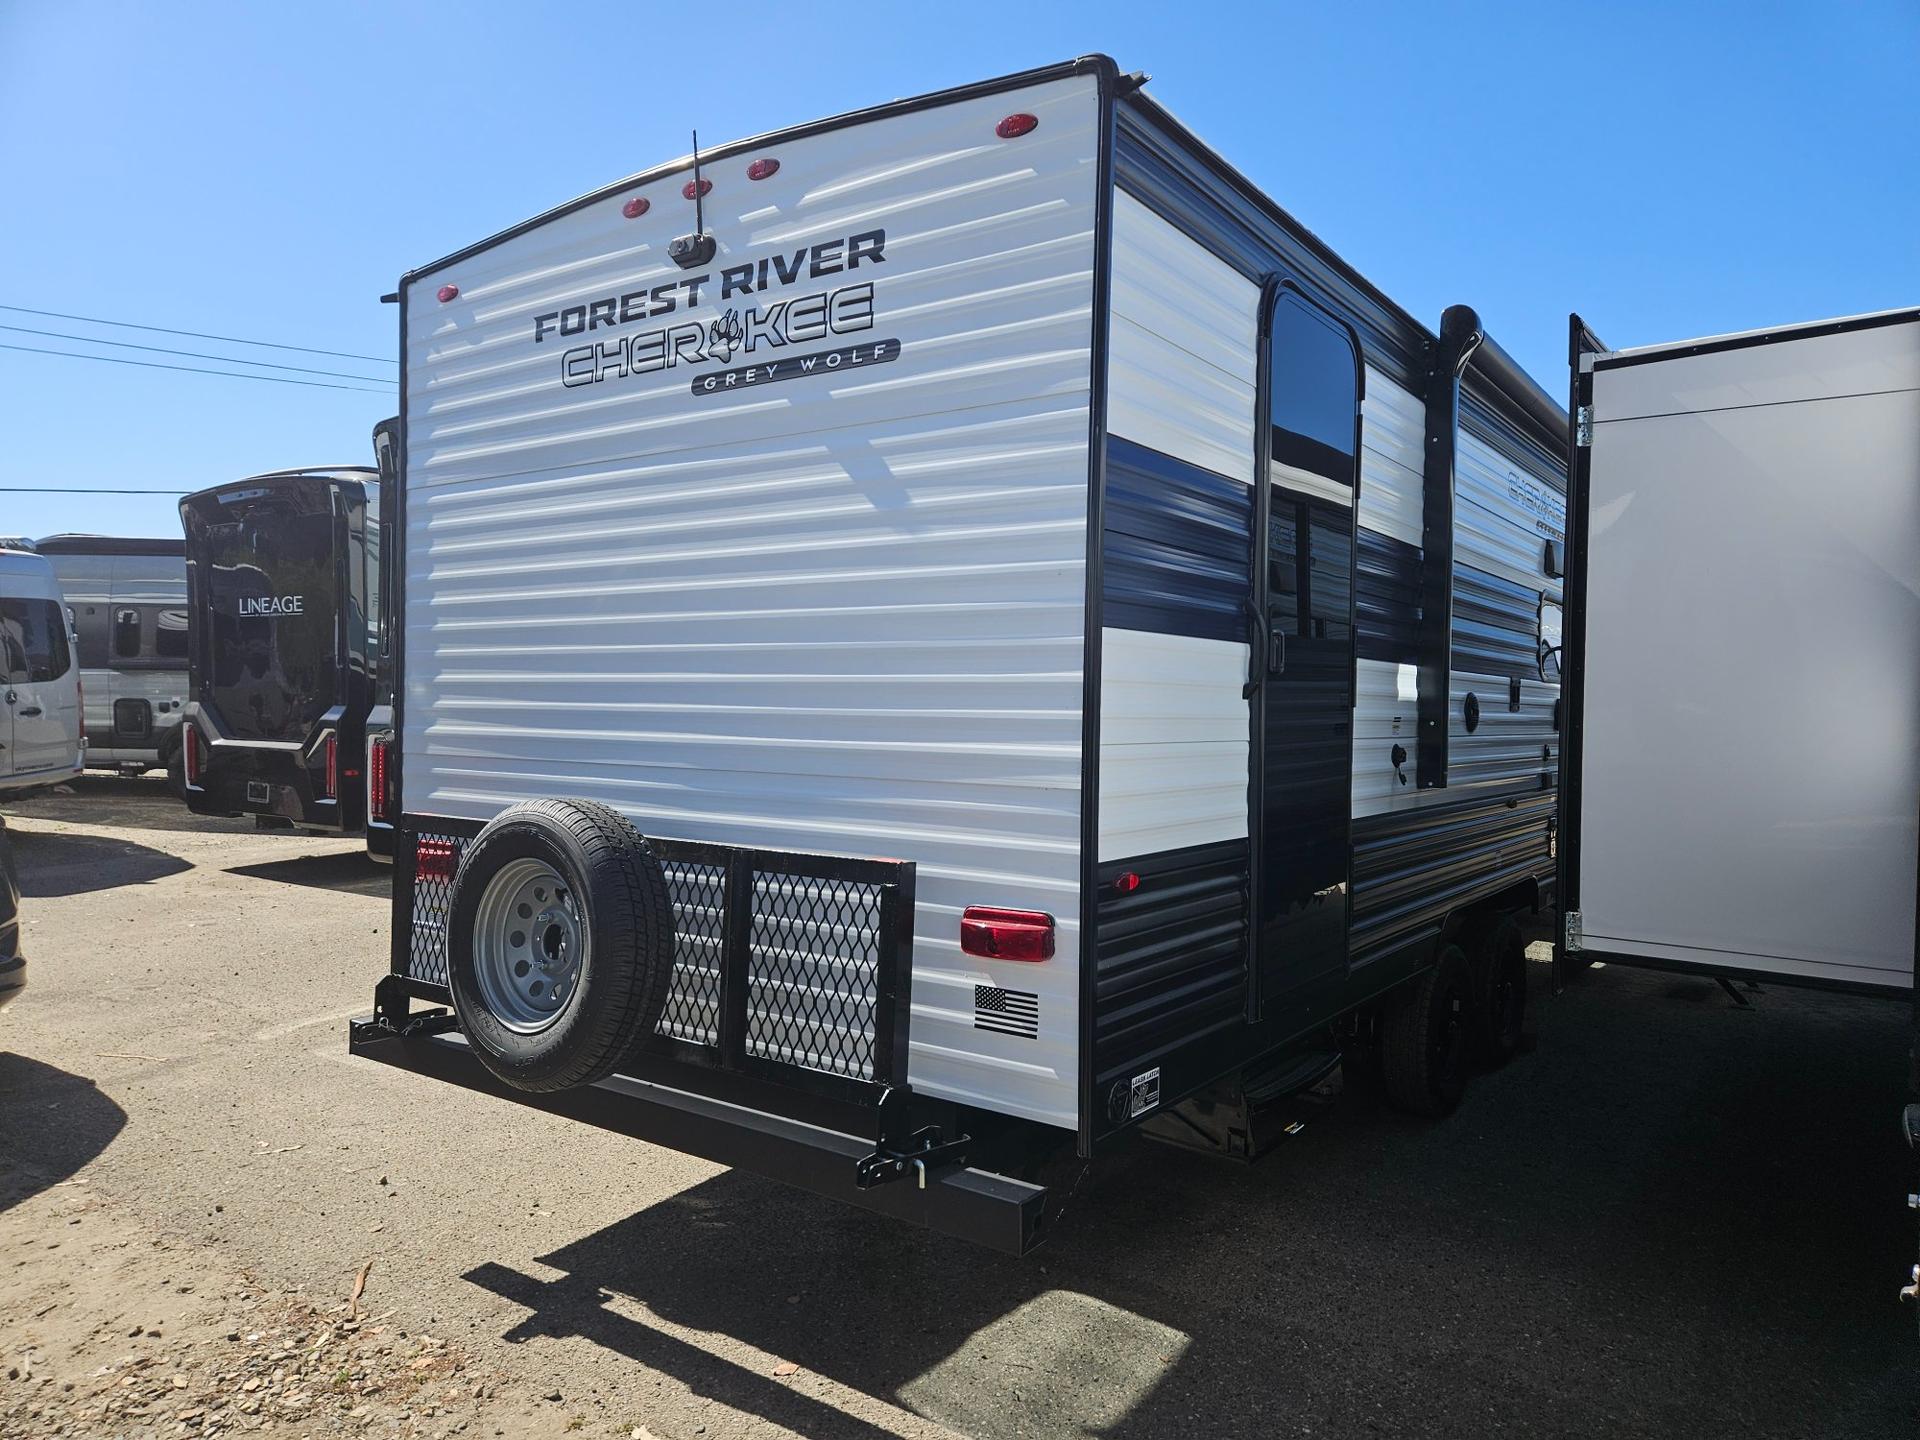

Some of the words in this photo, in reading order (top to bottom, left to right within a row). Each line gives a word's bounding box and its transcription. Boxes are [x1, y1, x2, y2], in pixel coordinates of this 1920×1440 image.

[533, 274, 710, 344] FOREST
[720, 228, 886, 300] RIVER
[704, 364, 778, 391] GREY
[800, 344, 886, 373] WOLF
[239, 595, 304, 614] LINEAGE
